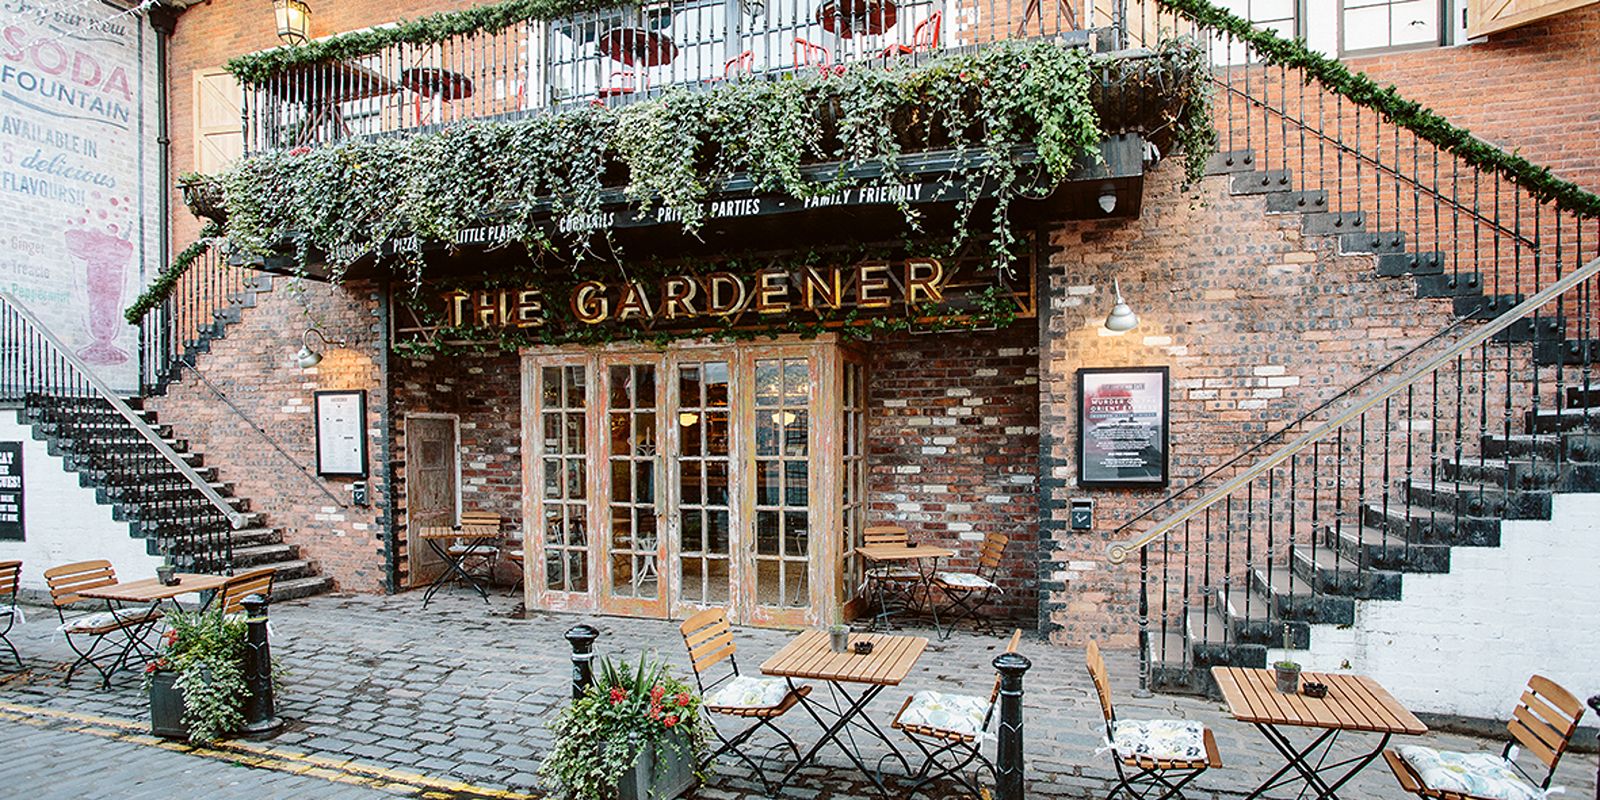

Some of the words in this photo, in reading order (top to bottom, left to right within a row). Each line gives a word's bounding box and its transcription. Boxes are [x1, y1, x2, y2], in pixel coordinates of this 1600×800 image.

[52, 11, 86, 26] our
[87, 17, 126, 36] new
[3, 25, 131, 102] SODA
[1, 64, 130, 123] FOUNTAIN
[2, 114, 80, 153] AVAILABLE
[83, 139, 98, 159] IN
[3, 143, 14, 165] 5
[20, 148, 117, 189] delicious
[455, 226, 486, 244] LITTLE
[711, 198, 760, 218] PARTIES
[439, 287, 545, 328] THE
[569, 258, 944, 324] GARDENER
